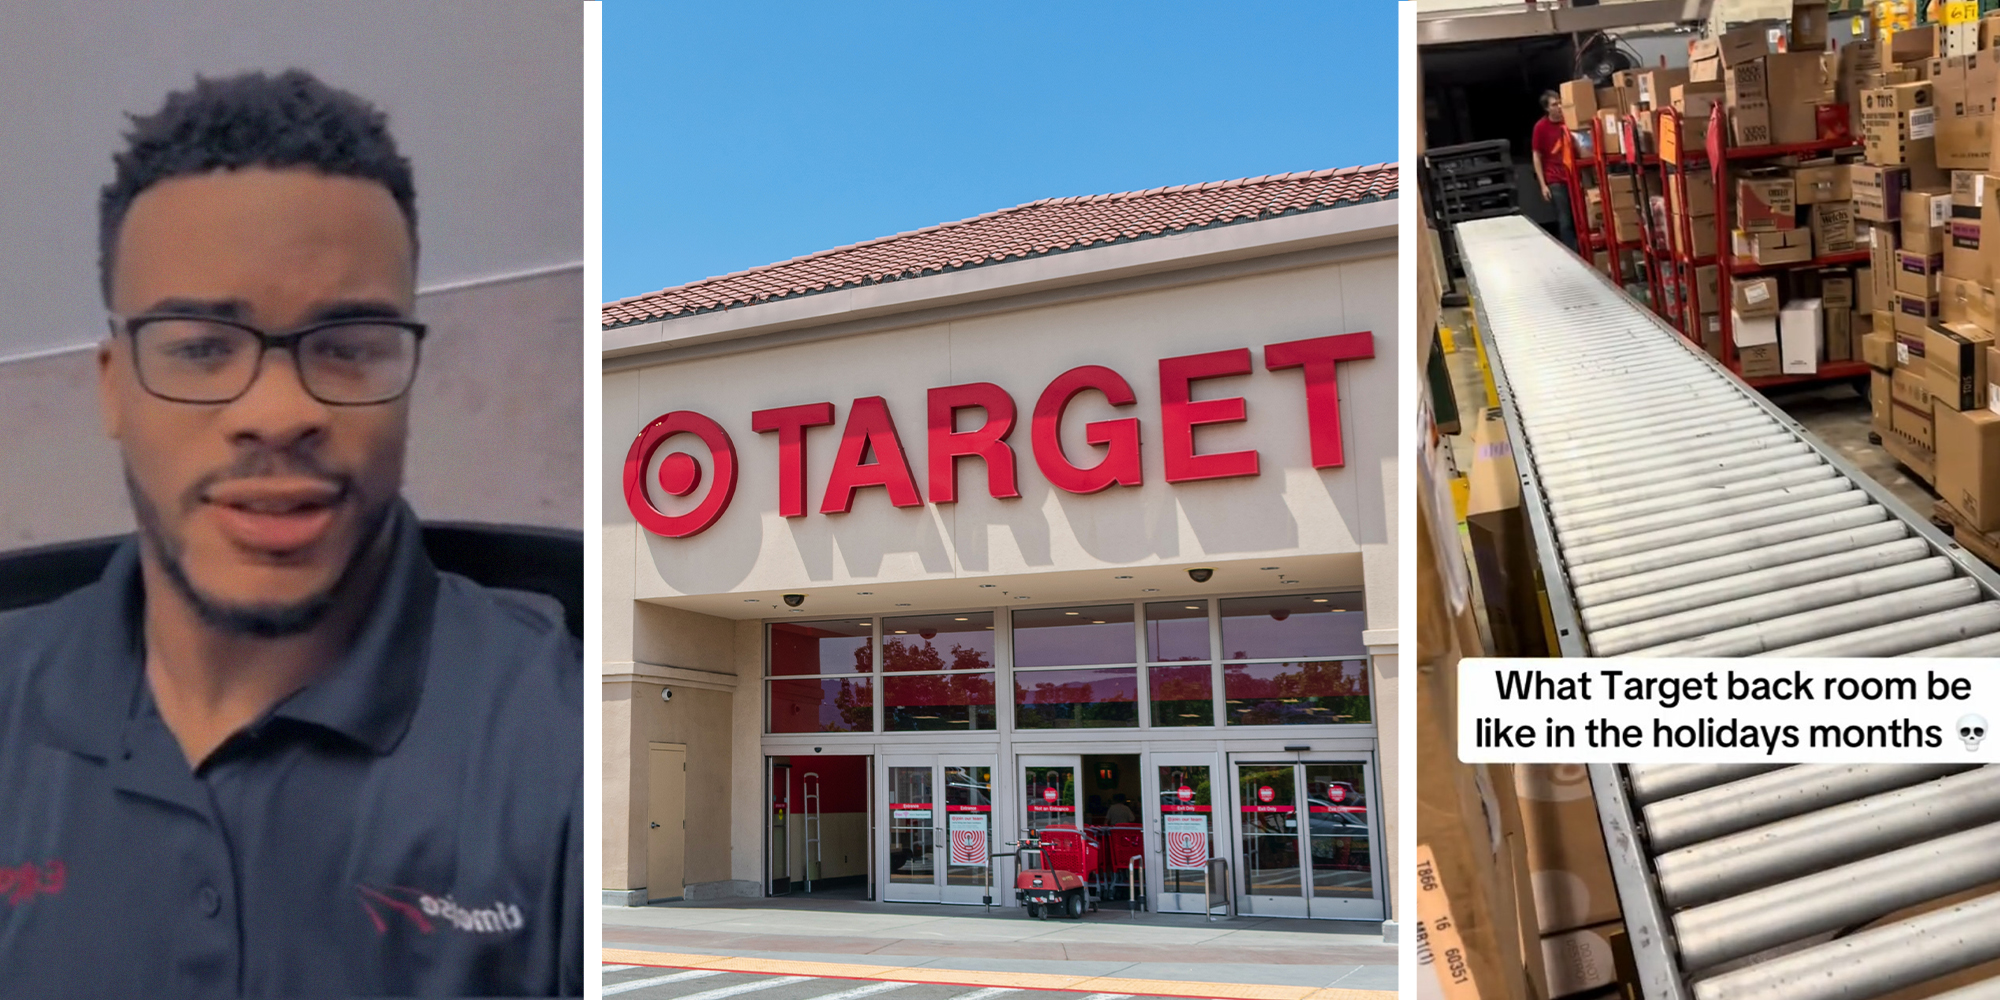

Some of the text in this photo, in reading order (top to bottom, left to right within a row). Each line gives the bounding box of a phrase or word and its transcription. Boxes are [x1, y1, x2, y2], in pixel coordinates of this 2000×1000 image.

[1877, 95, 1894, 108] TOYS
[752, 330, 1375, 518] TARGET
[1416, 860, 1468, 984] T866 16 60351
